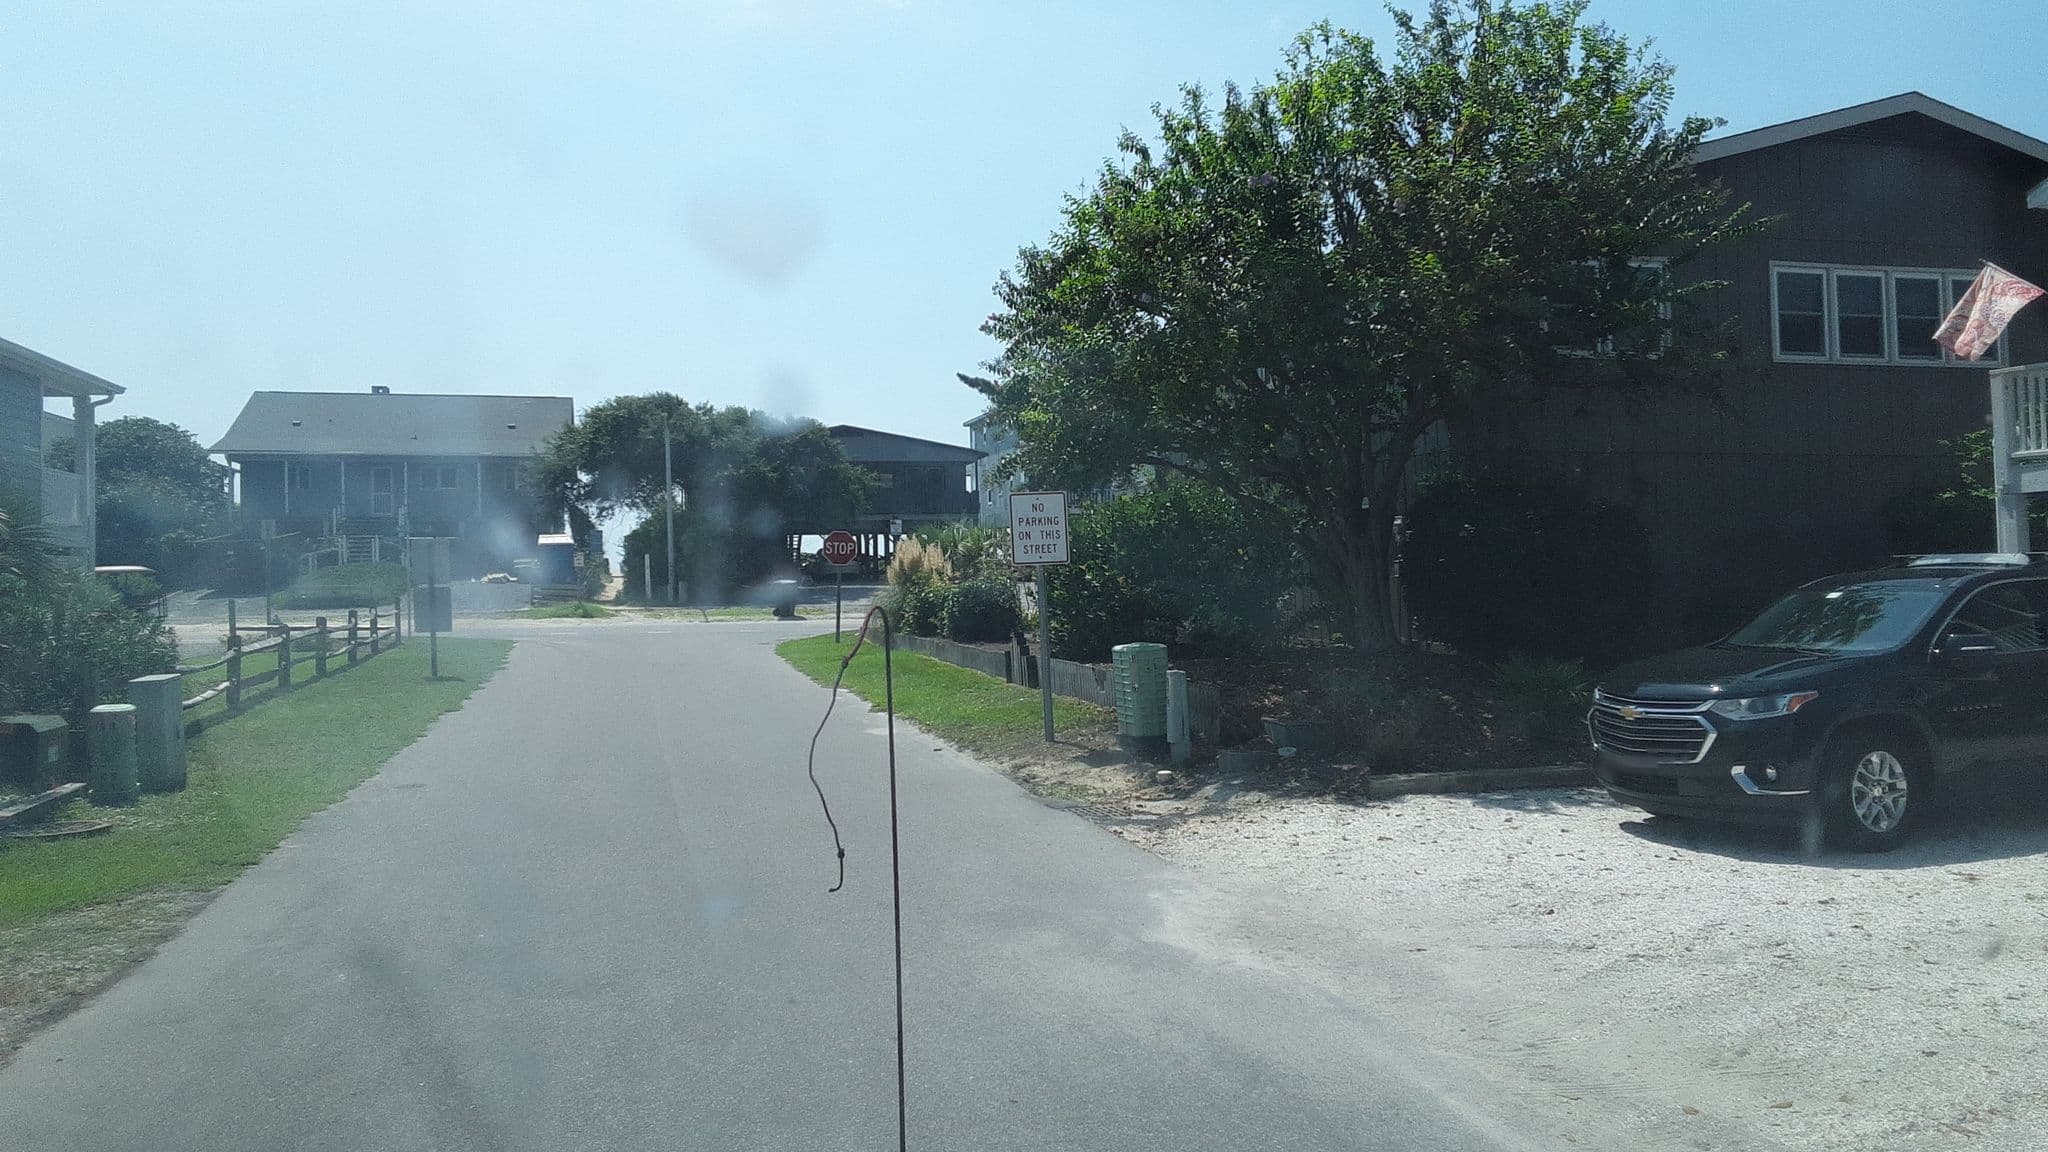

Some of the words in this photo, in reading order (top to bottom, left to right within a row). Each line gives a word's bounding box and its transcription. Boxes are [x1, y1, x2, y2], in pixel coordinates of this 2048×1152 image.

[1031, 502, 1045, 513] NO
[1018, 516, 1059, 527] PARKING
[1018, 530, 1032, 541] ON
[1040, 529, 1061, 540] THIS
[825, 541, 855, 555] STOP
[1023, 543, 1057, 554] STREET
